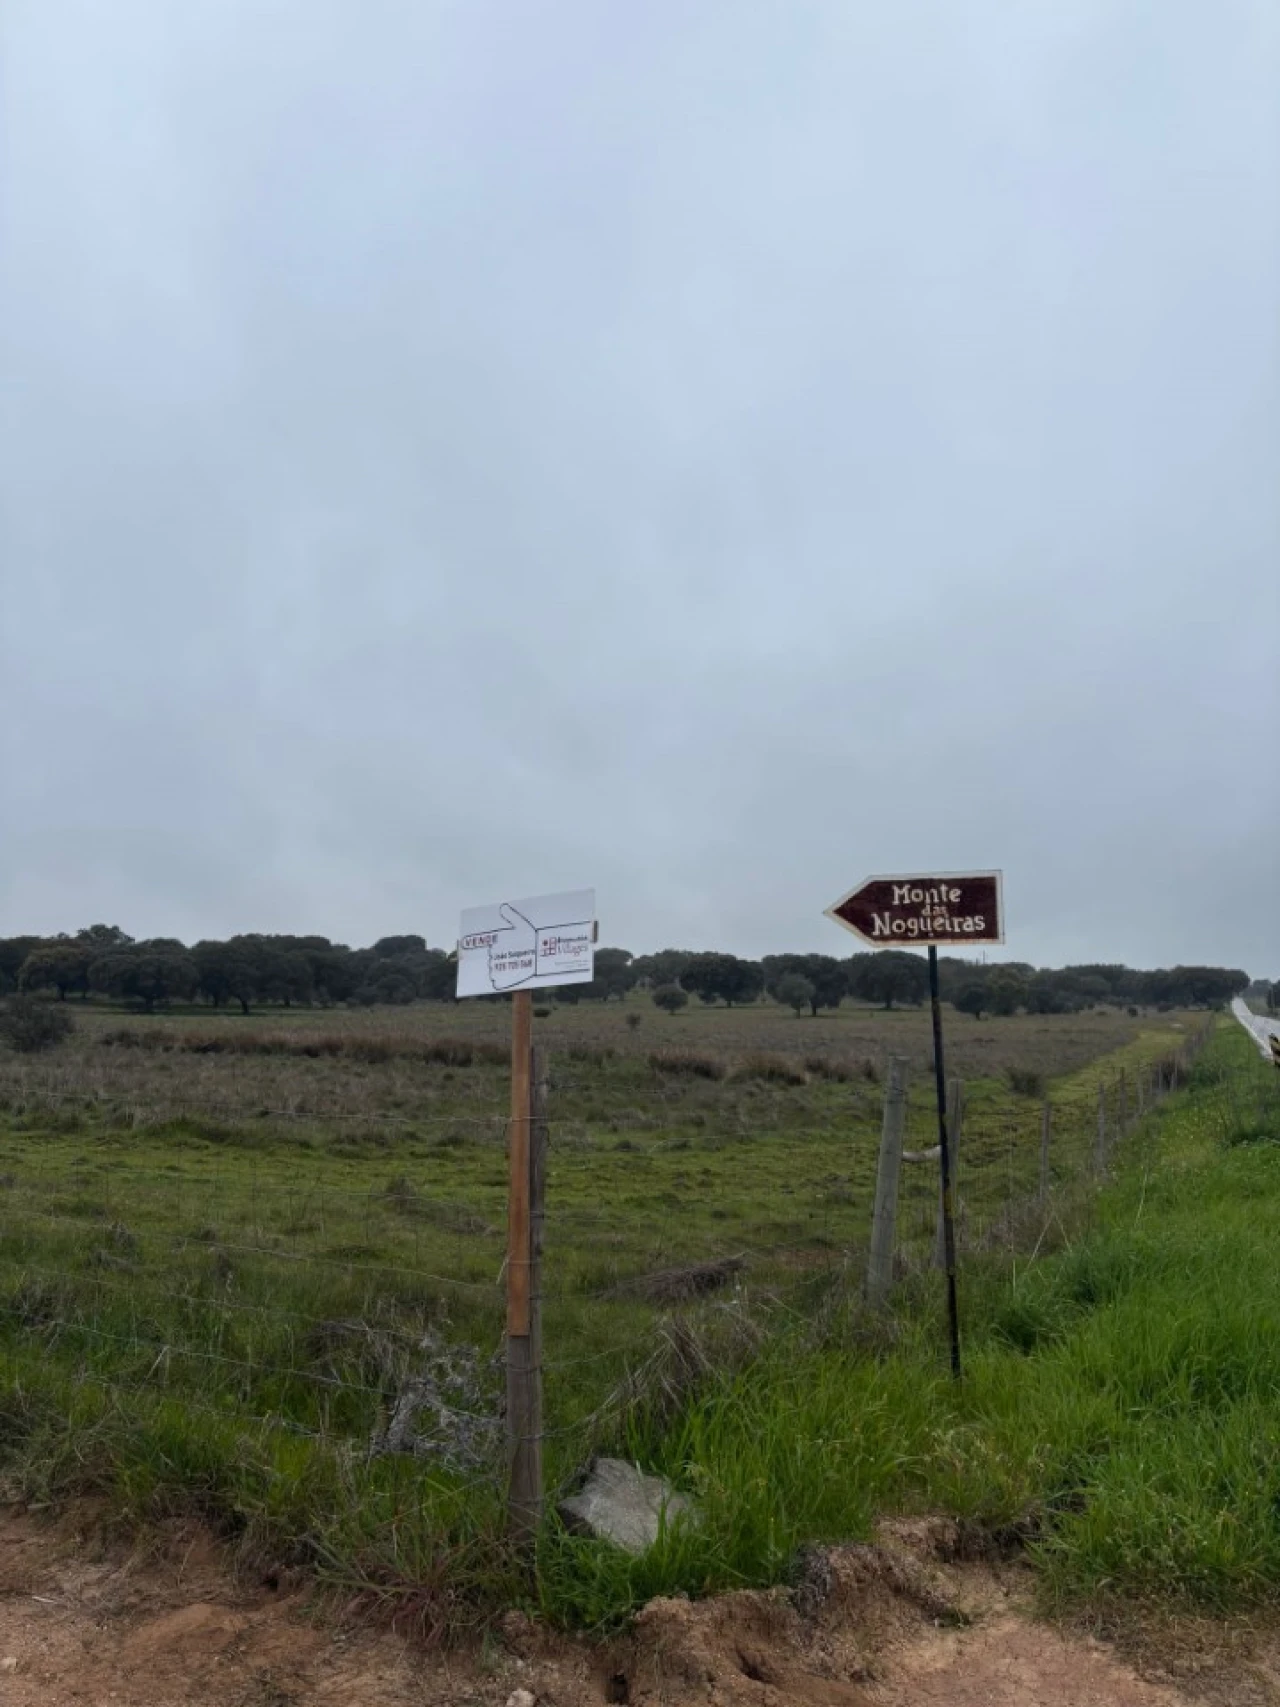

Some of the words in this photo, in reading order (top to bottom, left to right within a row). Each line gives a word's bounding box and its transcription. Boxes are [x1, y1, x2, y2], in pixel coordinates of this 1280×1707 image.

[892, 884, 962, 905] Monte
[871, 911, 985, 937] Nogueiras
[465, 934, 498, 947] VENDE
